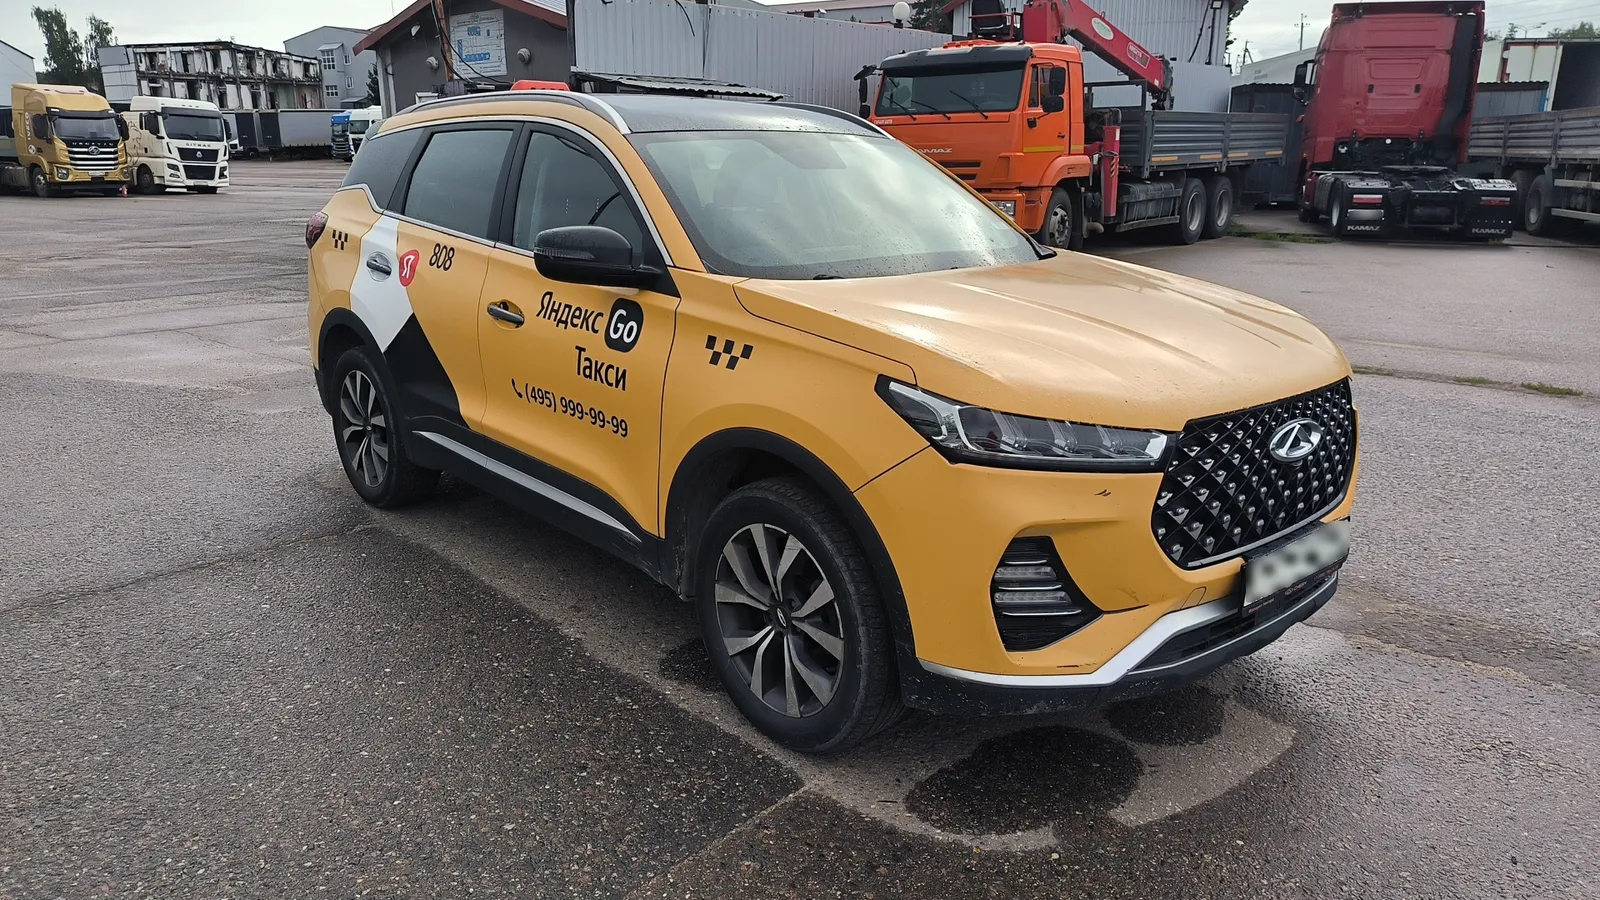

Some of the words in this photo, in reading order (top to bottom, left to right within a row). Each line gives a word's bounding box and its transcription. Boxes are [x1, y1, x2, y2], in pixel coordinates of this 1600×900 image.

[401, 255, 415, 279] Я
[429, 242, 455, 272] 808
[536, 291, 604, 334] Яндекс
[609, 308, 638, 343] Go
[575, 345, 627, 392] Такси
[525, 382, 557, 413] (495)
[560, 396, 628, 438] 999-99-99
